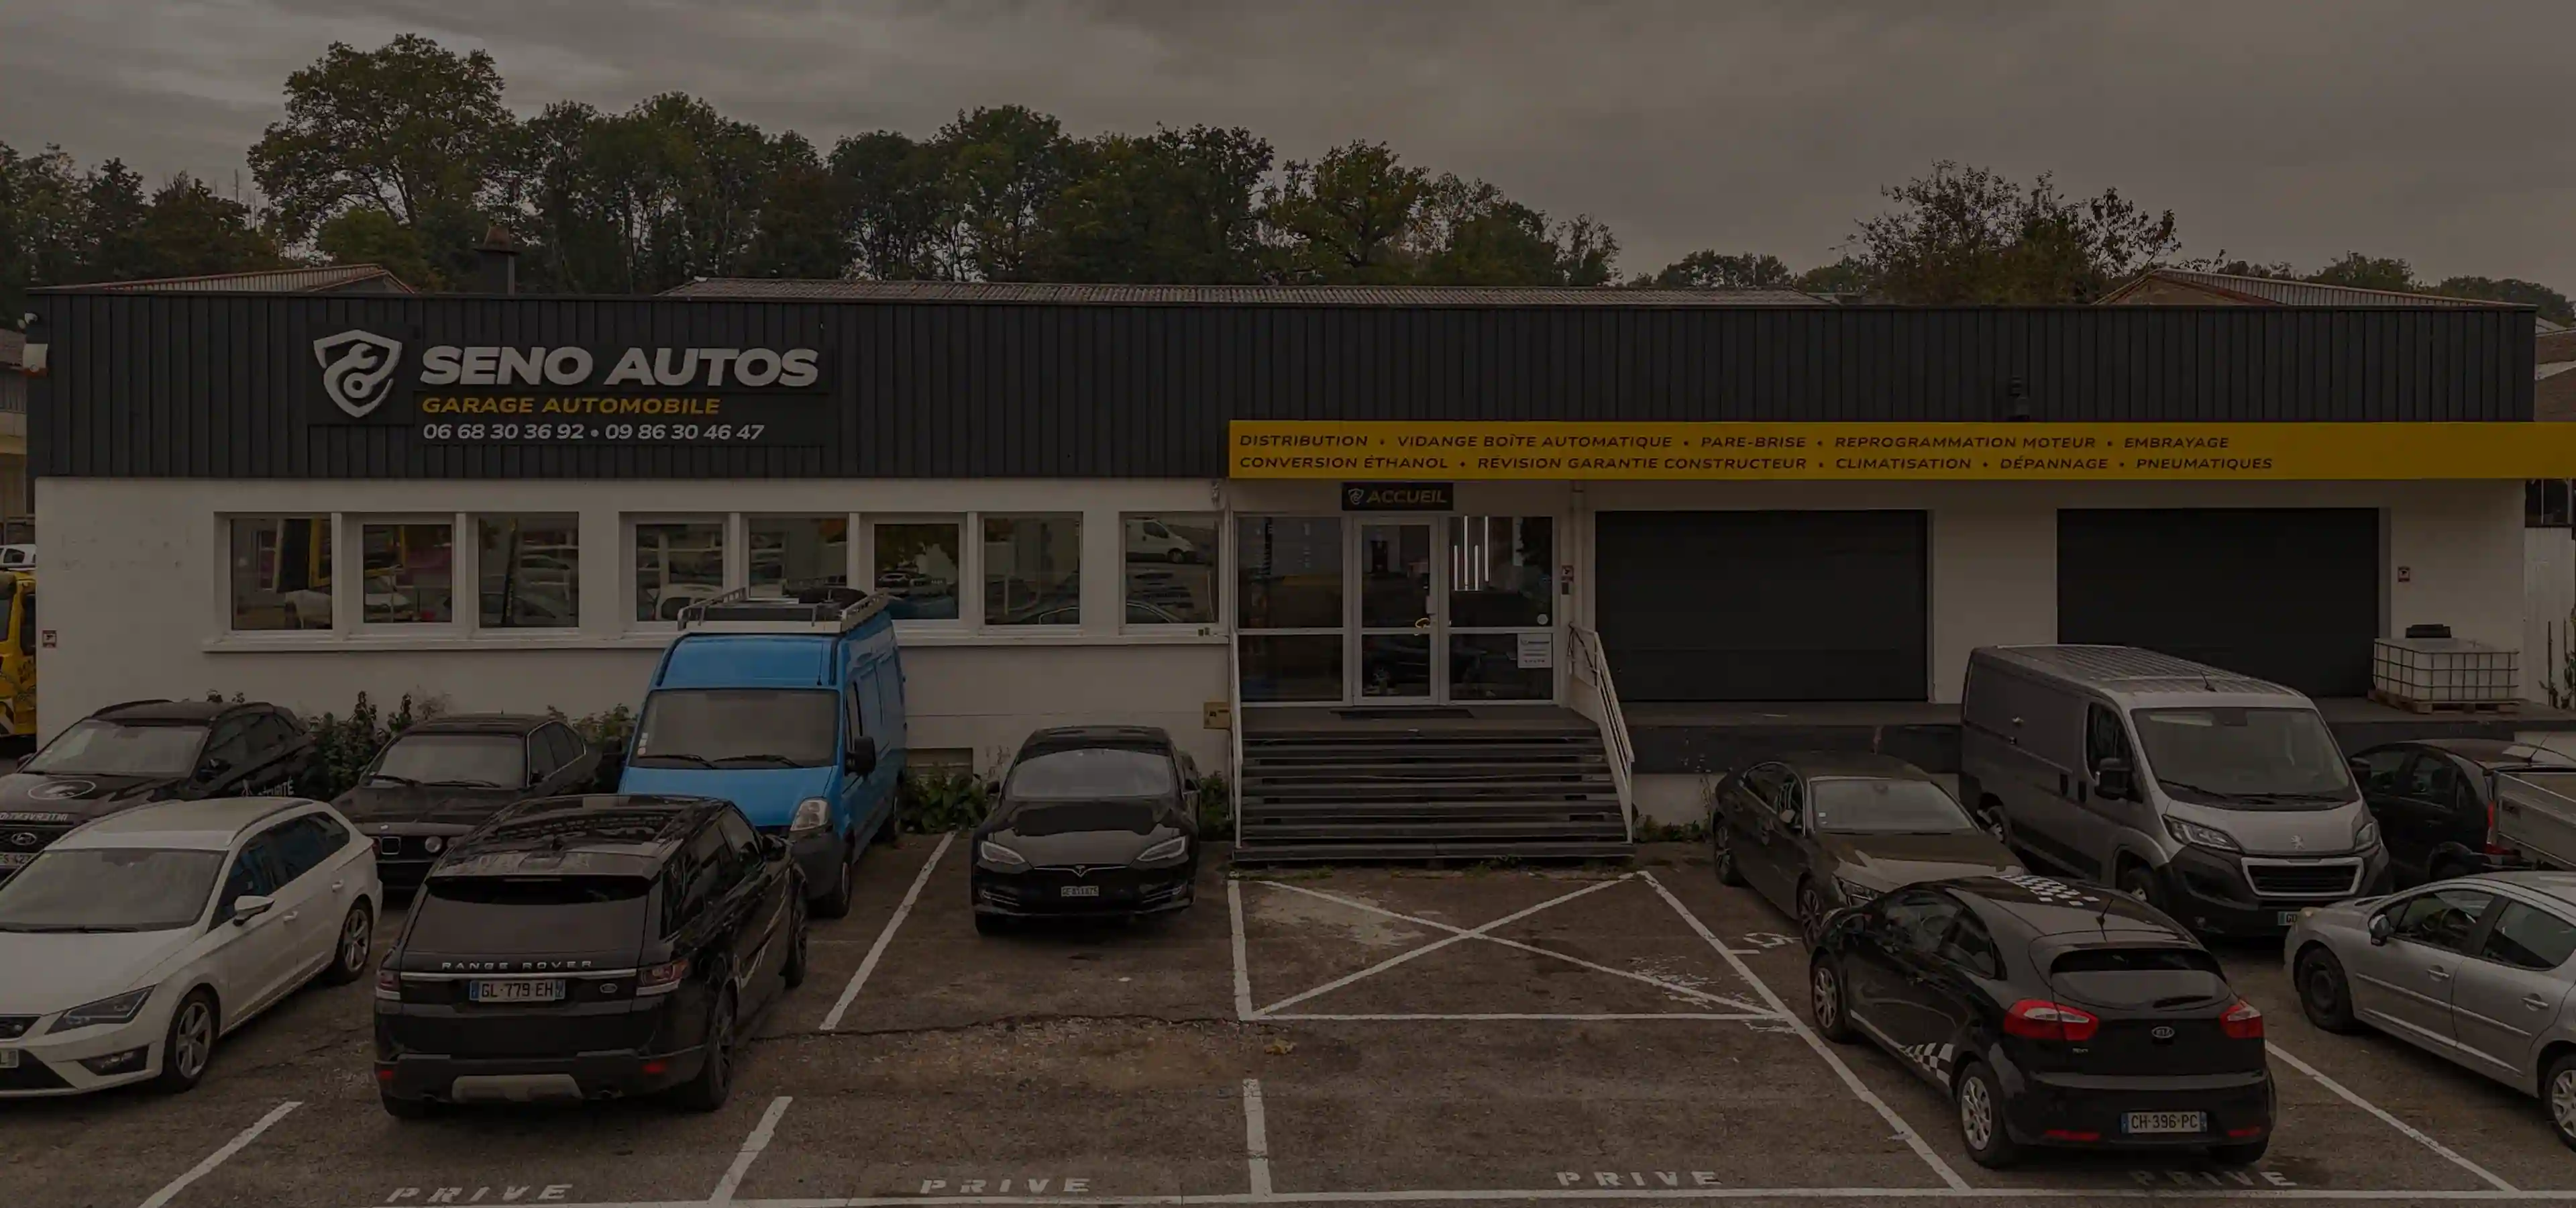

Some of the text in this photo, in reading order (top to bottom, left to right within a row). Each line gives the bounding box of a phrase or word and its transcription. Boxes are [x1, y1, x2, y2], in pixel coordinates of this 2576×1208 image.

[420, 346, 818, 388] SENO AUTOS
[422, 397, 720, 415] GARAGE AUTOMOBILE
[423, 424, 765, 440] 06 68 30 36 92 09 86 30 46 47
[1240, 433, 2229, 449] DISTRIBUTION VIDANGE BOÎTE AUTOMATIQUE PARE-BRISE REPROGRAMMATION MOTEUR EMBRAYAGE
[1240, 454, 2273, 471] CONVERSION ÉTHANOL RÉVISION GARANTIE CONSTRUCTEUR CLIMATISATION DÉPANNAGE PNEUMATIQUES
[1366, 489, 1448, 503] ACCUEIL
[442, 960, 592, 970] RANGE ROVER
[920, 1178, 1091, 1195] PRIVE
[1556, 1170, 1723, 1187] PRIVE
[384, 1183, 573, 1203] PRIVE
